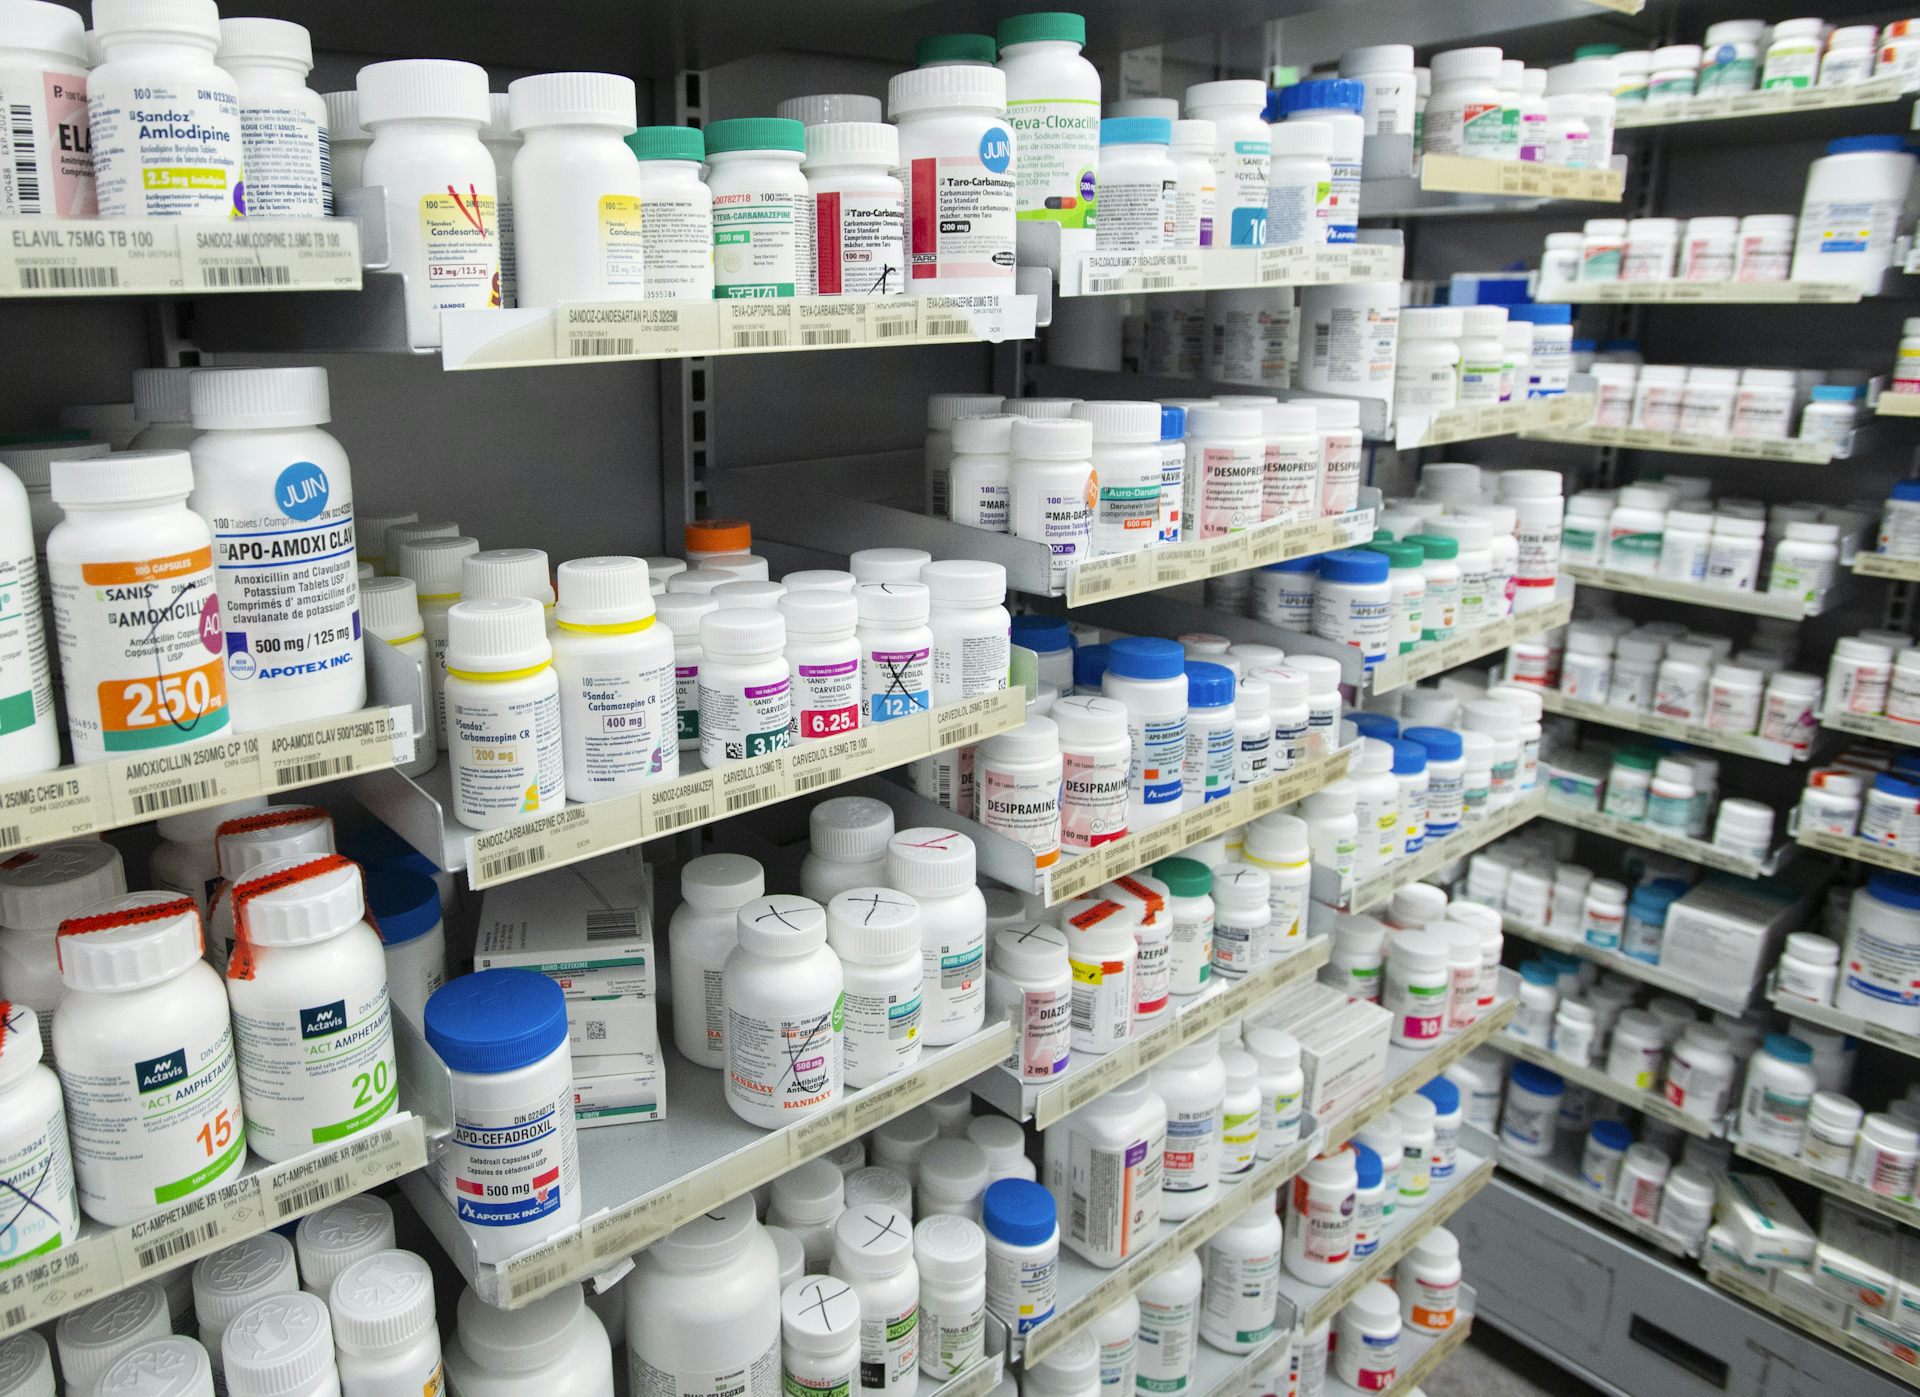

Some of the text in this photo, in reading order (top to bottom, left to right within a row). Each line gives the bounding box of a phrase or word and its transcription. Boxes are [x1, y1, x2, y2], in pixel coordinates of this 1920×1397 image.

[134, 89, 150, 99] 100
[137, 110, 190, 122] Sandoz
[139, 124, 229, 143] Amlodipine
[984, 140, 1009, 158] JUIN
[716, 194, 751, 204] 00782718
[760, 193, 774, 202] 100
[717, 211, 791, 221] TEVA-CARBAMAZEPINE
[432, 228, 483, 236] Candesartan
[957, 224, 969, 232] mg
[1251, 219, 1266, 244] 10
[13, 232, 152, 247] ELAVIL 75MG TB 100
[197, 233, 339, 249] SANDOZ-AMLODIPINE 2.5MG TB 100
[719, 234, 744, 243] 200 mg
[569, 310, 642, 323] SANDOZ-CANDESARTAN
[643, 310, 658, 322] PLUS
[732, 305, 790, 317] TEVA-CAPTOPRIL 25MG
[284, 475, 326, 507] JUIN
[980, 512, 1004, 520] Dapsone
[214, 519, 257, 529] 100 Tablets
[1046, 524, 1070, 532] Dapsone
[1141, 520, 1150, 528] mg
[228, 527, 352, 560] APO-AMOXI CLAV
[234, 560, 350, 584] Amoxicillin and Clavulanate
[244, 575, 344, 596] Potassium Tablets USP
[106, 588, 152, 601] SANIS
[256, 639, 281, 653] 500
[284, 639, 304, 652] mg
[314, 632, 334, 645] 125
[337, 626, 349, 640] mg
[259, 654, 353, 679] APOTEX INC.
[123, 671, 221, 726] 250 mg
[588, 692, 614, 700] Sandoz
[589, 696, 655, 711] Carbamazepine CR
[885, 699, 918, 715] 12.5
[938, 709, 967, 723] CARVEDILOL
[969, 703, 982, 714] 25MG
[984, 700, 990, 709] TB
[460, 722, 482, 731] Sandoz
[607, 717, 642, 728] 400 mg
[812, 713, 850, 732] 6.25
[272, 718, 394, 753] APO-AMOXI CLAV 500/125MG TB 10
[460, 730, 530, 743] Carbamazepine CR
[754, 729, 789, 755] 3.125
[126, 738, 258, 780] AMOXICILLIN 250MG CP 100
[476, 750, 513, 761] 200 mg
[793, 738, 867, 767] CARVEDILOL 6.25MG TB 100
[1066, 779, 1128, 793] DESIPRAMINE
[5, 780, 79, 808] 250MG CHEW TB
[989, 800, 1055, 813] DESIPRAMINE
[478, 809, 585, 850] SANDOZ-CARBAMAZEPINE CR 200MG
[1062, 831, 1078, 839] 100
[307, 1017, 342, 1032] Actavis
[1421, 1020, 1437, 1034] 10
[310, 1042, 331, 1055] ACT
[144, 1067, 182, 1085] Actavis
[1028, 1066, 1048, 1075] 2 mg
[352, 1061, 387, 1109] 20
[730, 1072, 774, 1094] RANBAXY
[148, 1095, 171, 1110] ACT
[784, 1090, 832, 1108] RANBAXY
[515, 1102, 555, 1124] DIN 02240774
[197, 1108, 231, 1157] 15
[457, 1121, 552, 1144] APO-CEFADROXIL
[273, 1129, 392, 1188] ACT-AMPHETAMINE XR 20MG CP 100
[487, 1184, 529, 1196] 500 mg
[131, 1179, 250, 1240] ACT-AMPHETAMINE XR 15MG CP
[477, 1207, 542, 1220] APOTEX INC.
[22, 1218, 46, 1236] mg
[12, 1253, 79, 1291] XR 10MG CP 100
